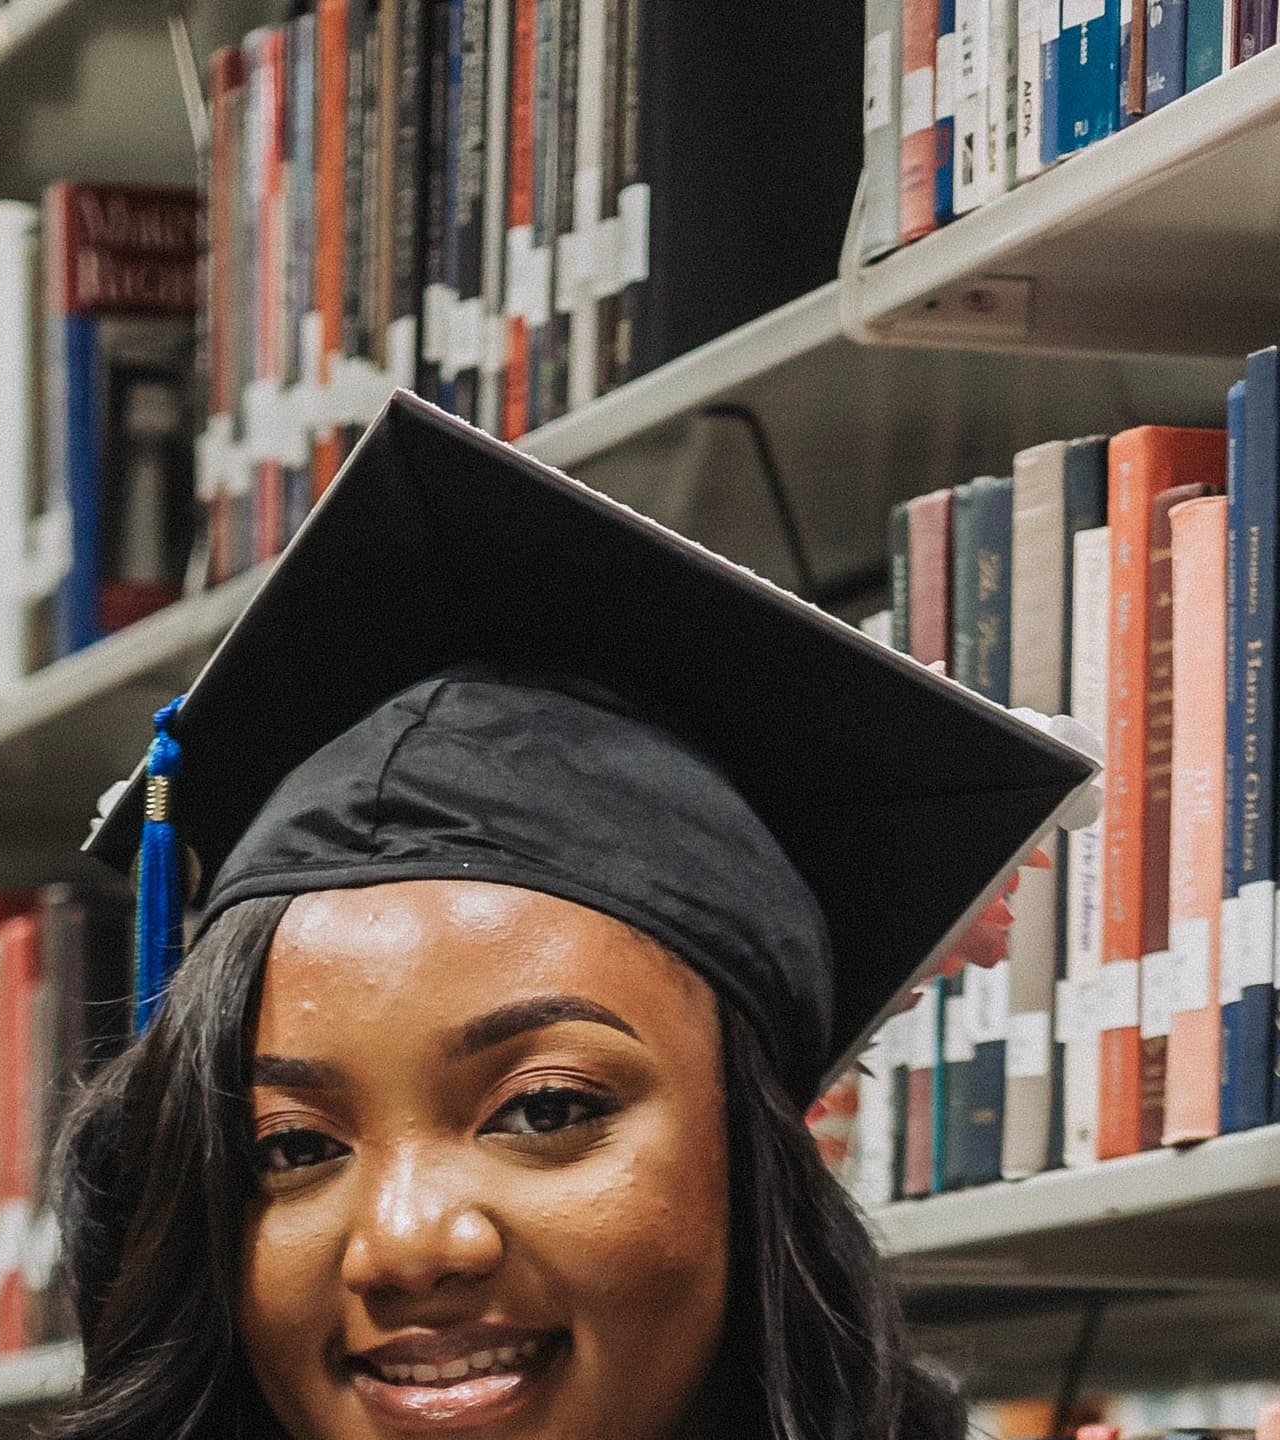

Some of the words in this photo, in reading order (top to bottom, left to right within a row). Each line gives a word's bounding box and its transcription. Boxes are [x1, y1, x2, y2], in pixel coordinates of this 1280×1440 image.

[1245, 639, 1264, 725] Harm
[1245, 733, 1261, 763] to
[1242, 772, 1261, 871] Others
